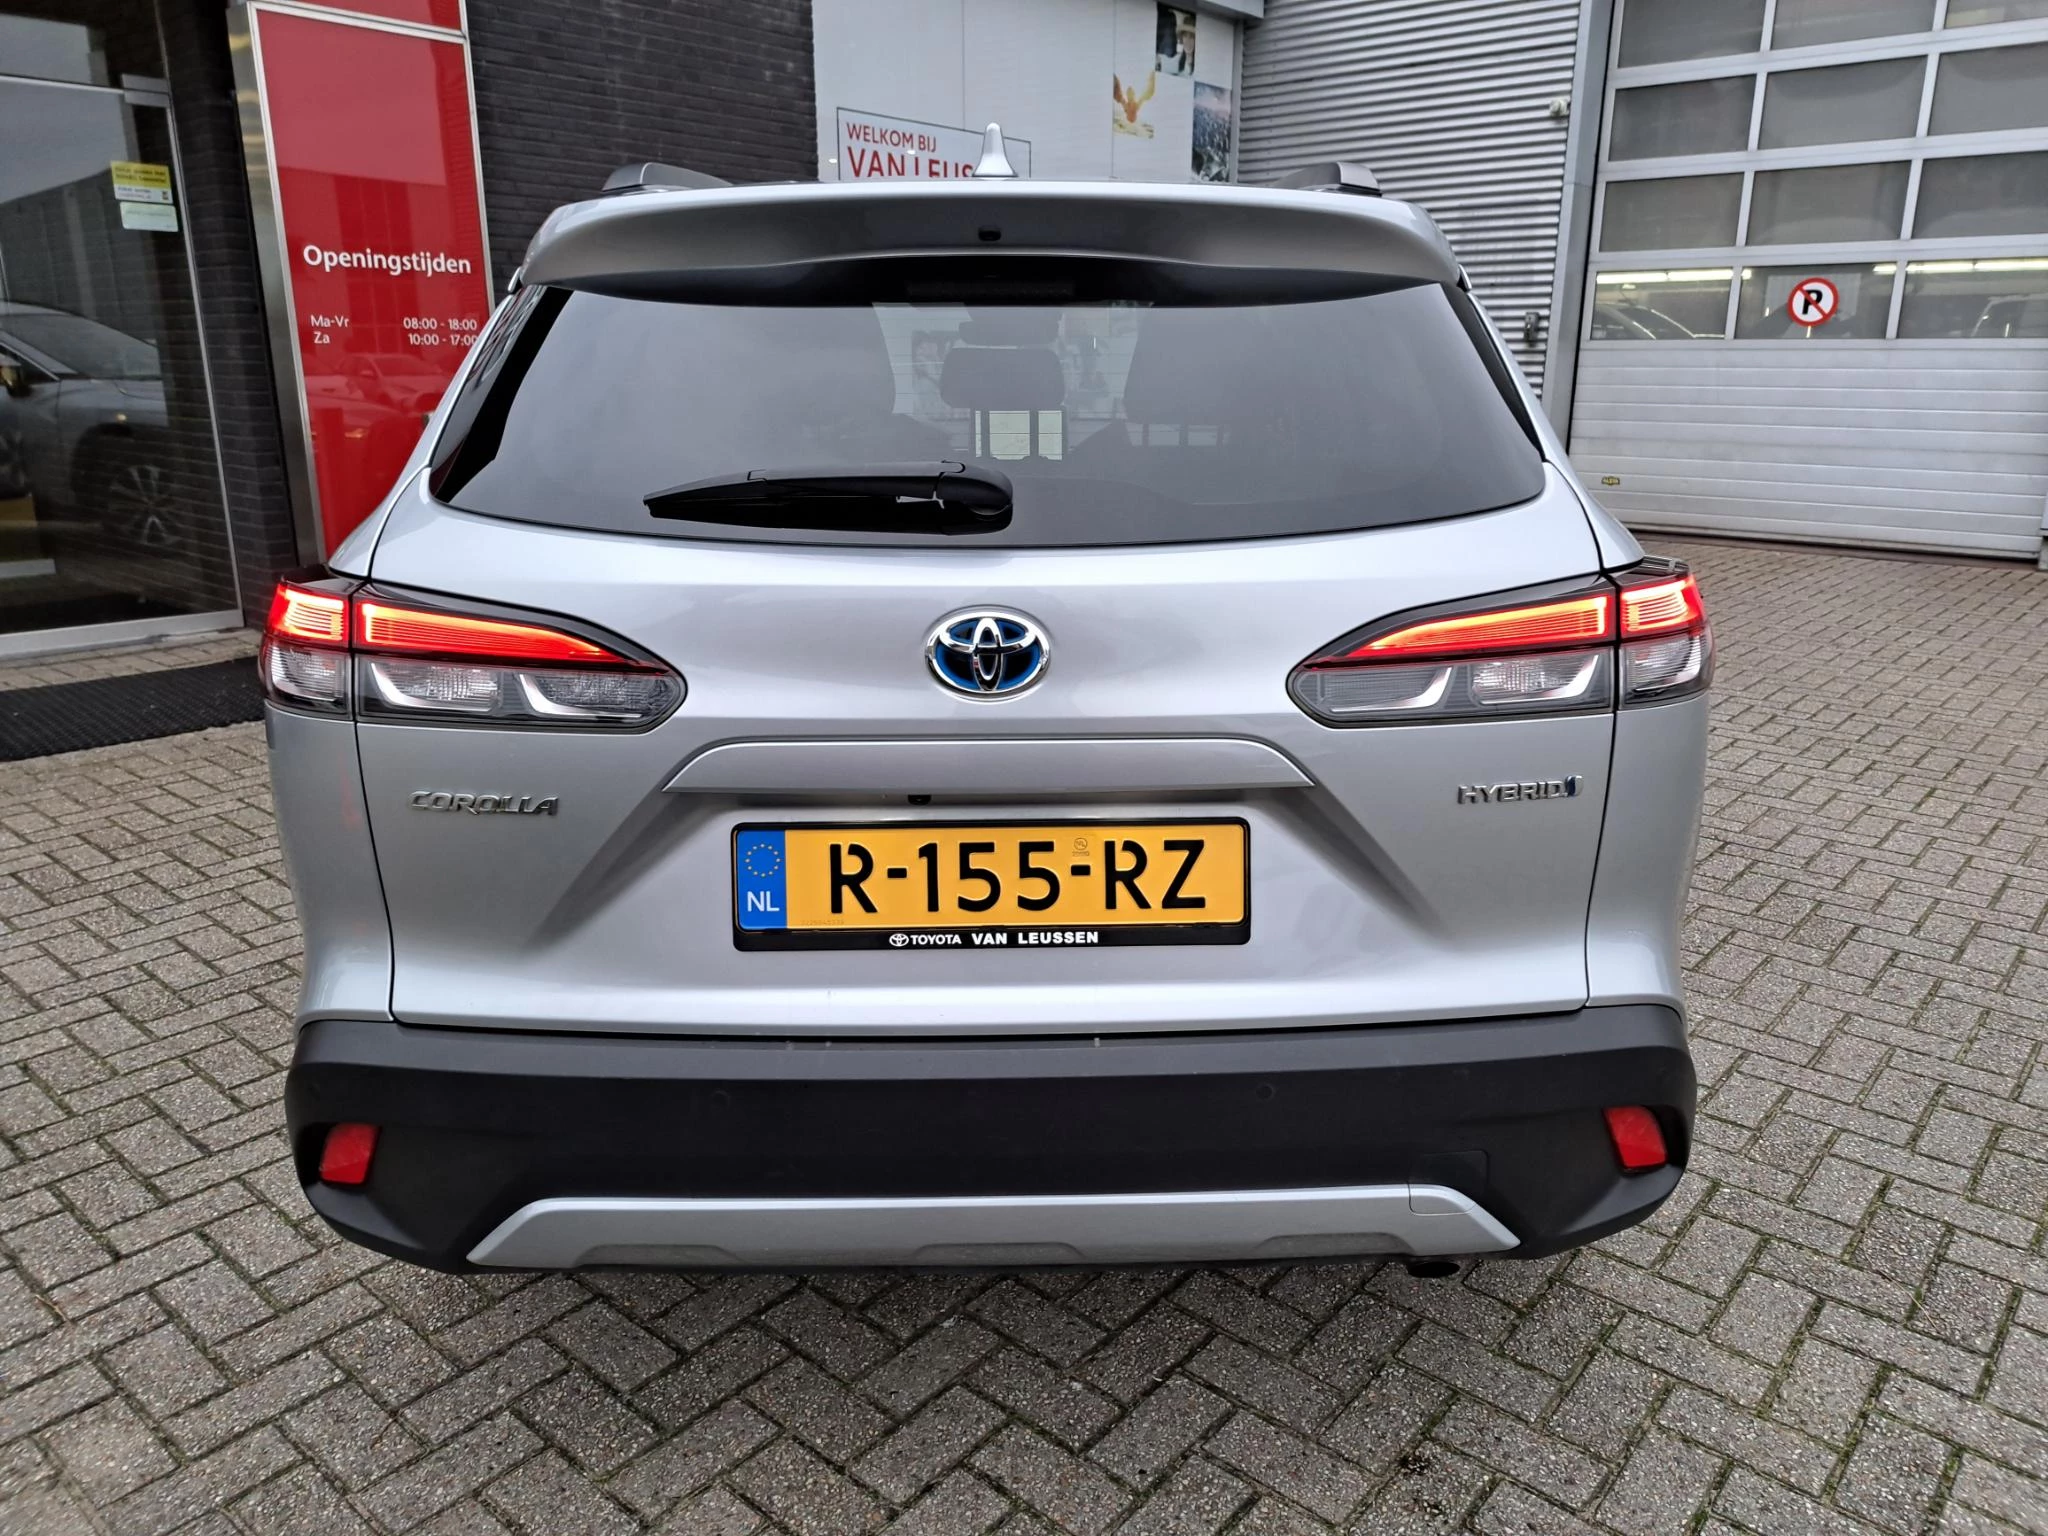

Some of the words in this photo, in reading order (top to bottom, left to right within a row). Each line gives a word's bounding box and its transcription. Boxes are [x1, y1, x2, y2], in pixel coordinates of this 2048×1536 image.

[846, 121, 914, 150] WELKOM
[918, 134, 937, 153] BIJ
[846, 146, 906, 178] VAN
[303, 244, 472, 278] Openingstijden
[1802, 289, 1823, 315] P
[310, 314, 350, 328] Ma-Vr
[403, 317, 438, 331] 08:00
[448, 318, 478, 331] 18:00
[313, 331, 331, 344] Za
[408, 333, 439, 346] 10:00
[410, 790, 559, 816] COROLLA
[1457, 779, 1568, 804] HYBRID
[829, 839, 1207, 914] R-155-RZ
[747, 891, 780, 912] NL
[910, 933, 962, 946] TOYOTA
[971, 932, 1008, 946] VAN
[1017, 931, 1099, 945] LEUSSEN
